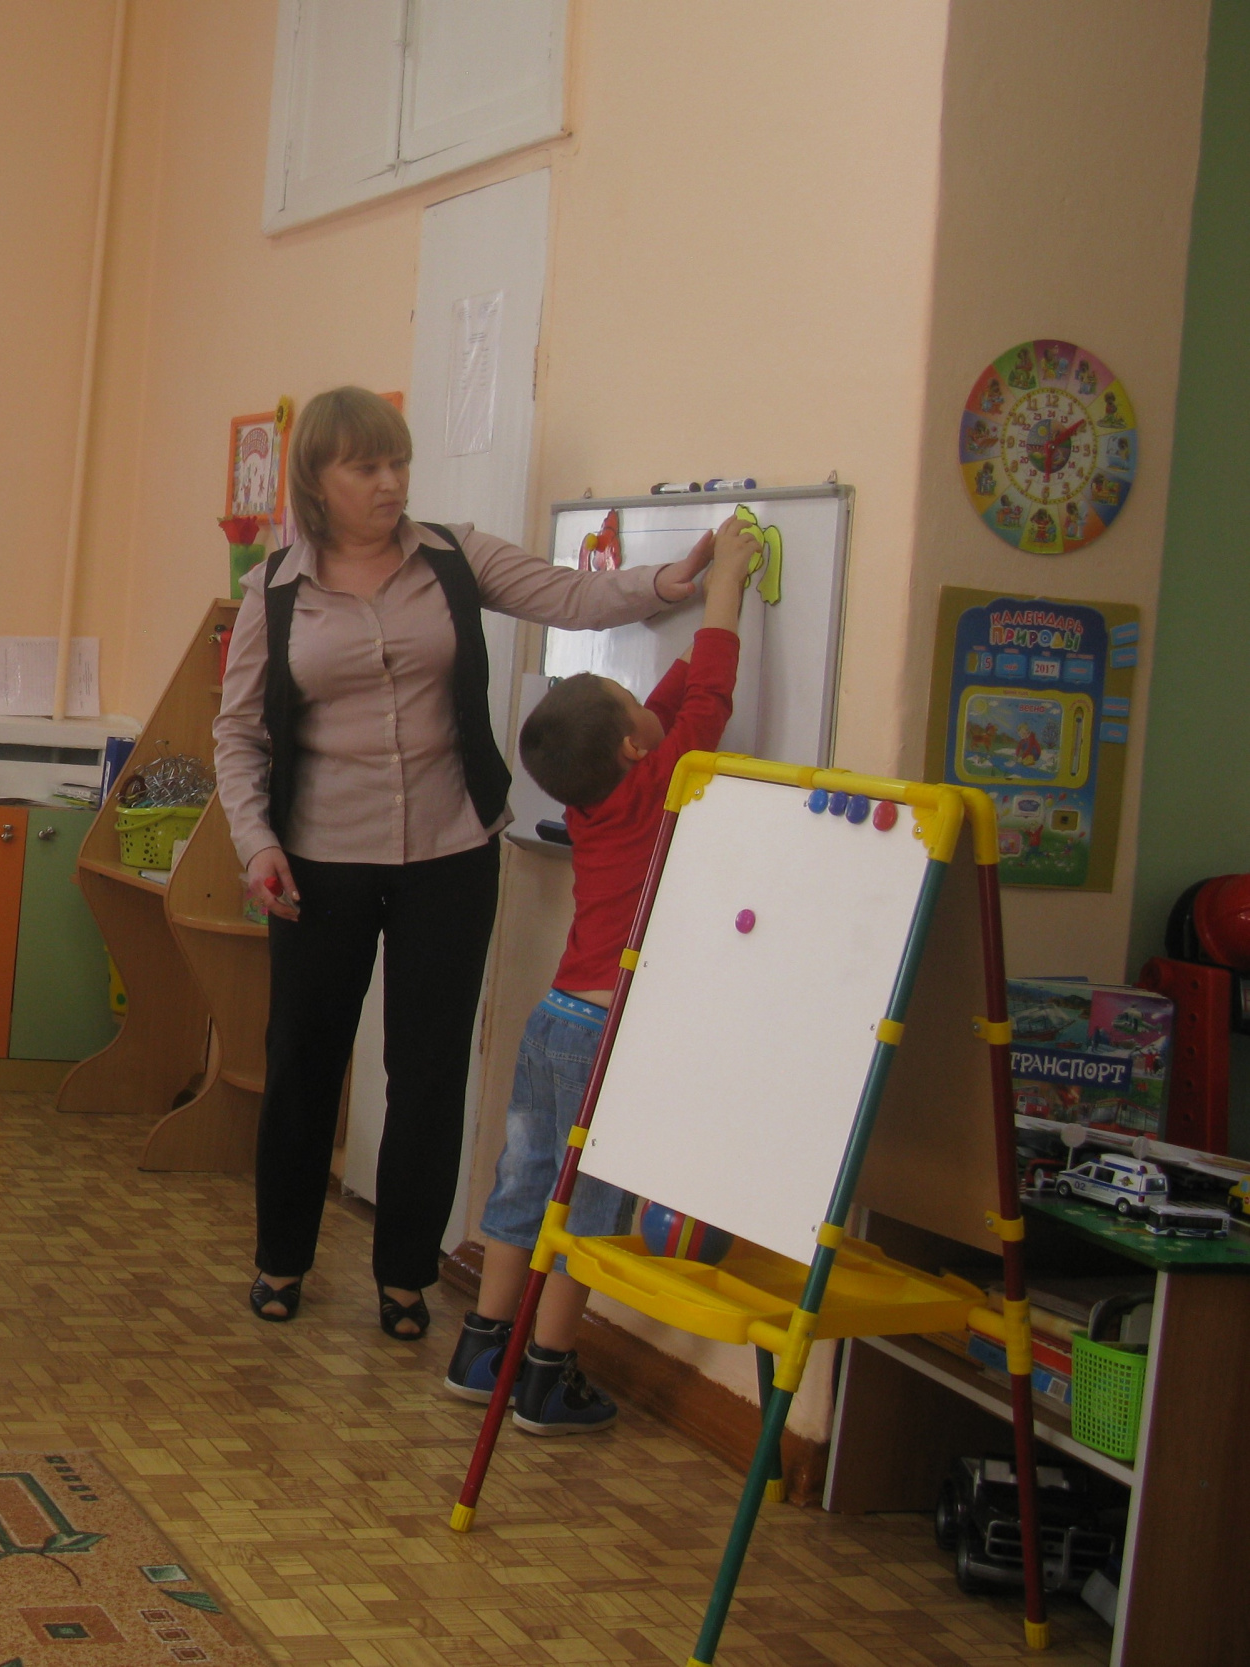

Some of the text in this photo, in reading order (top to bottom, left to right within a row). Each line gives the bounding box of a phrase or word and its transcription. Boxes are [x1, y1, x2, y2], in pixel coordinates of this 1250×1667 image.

[990, 609, 1084, 635] КАЛЕНДАРЬ
[989, 625, 1082, 652] ПРИРОДЫ
[984, 657, 991, 669] 5
[1034, 663, 1056, 675] 2017
[1010, 1051, 1126, 1084] ТРАНСПОРТ
[1074, 1180, 1086, 1191] 02
